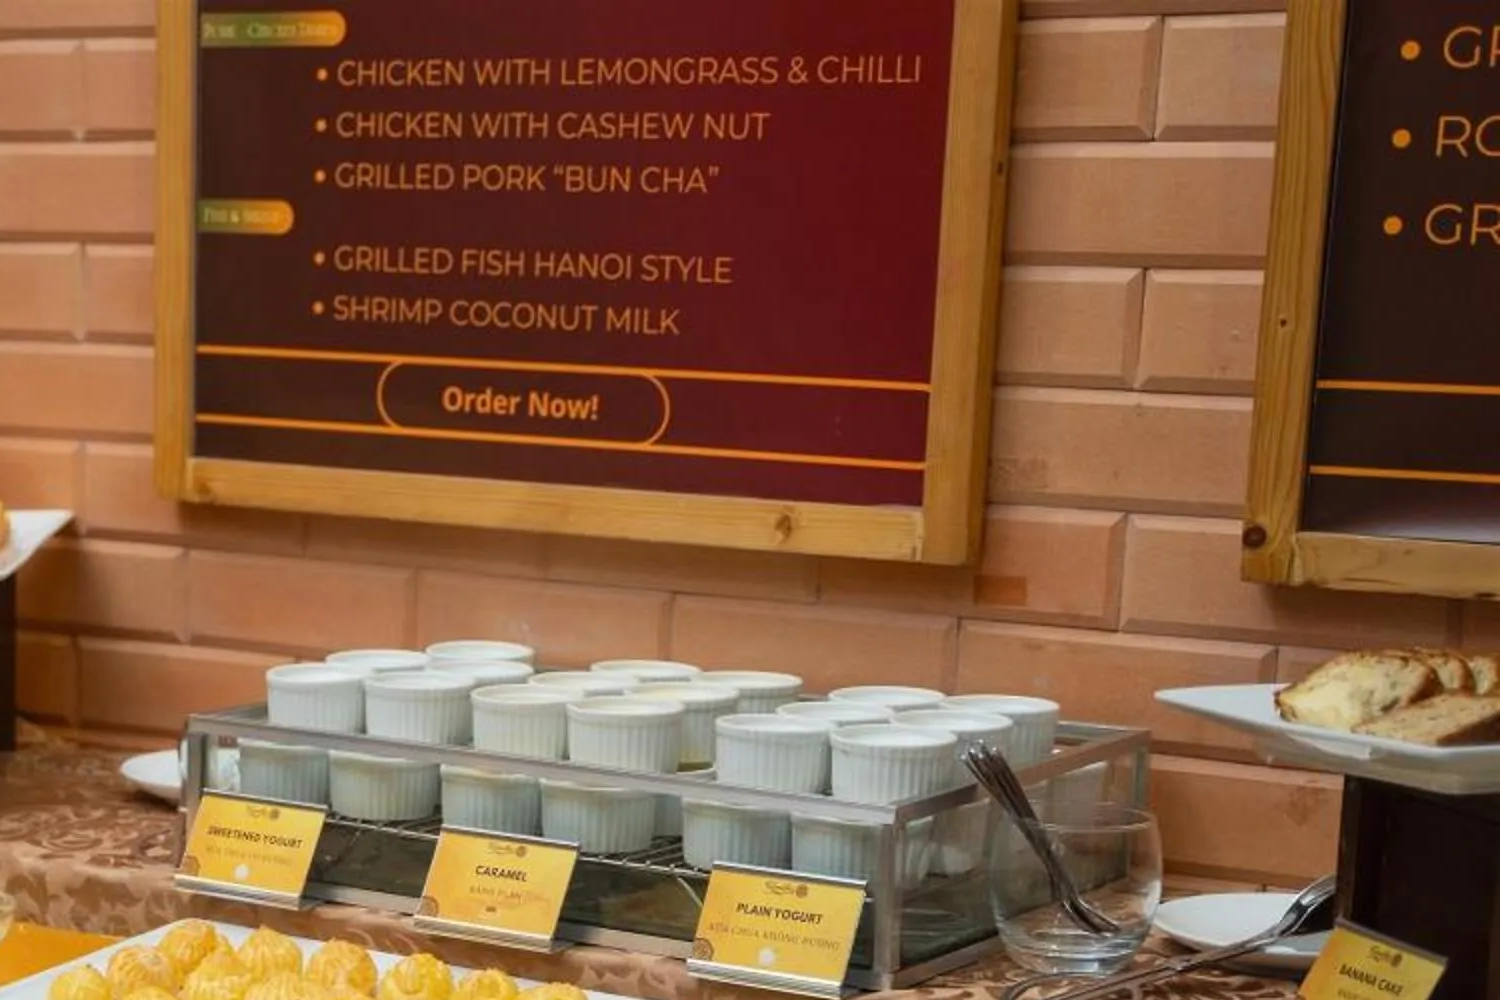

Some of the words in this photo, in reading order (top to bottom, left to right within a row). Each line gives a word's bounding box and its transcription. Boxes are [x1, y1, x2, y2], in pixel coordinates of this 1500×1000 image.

[336, 58, 466, 87] CHICKEN
[472, 57, 551, 86] WITH
[559, 56, 780, 86] LEMONGRASS
[786, 56, 809, 84] &
[816, 54, 922, 84] CHILLI
[335, 111, 464, 139] CHICKEN
[470, 111, 550, 139] WITH
[556, 111, 695, 140] CASHEW
[702, 112, 772, 141] NUT
[333, 162, 456, 190] GRILLED
[462, 163, 547, 192] PORK
[333, 245, 455, 275] GRILLED
[460, 248, 526, 277] FISH
[533, 252, 633, 281] HANOI
[640, 254, 733, 285] STYLE
[332, 294, 444, 326] SHRIMP
[448, 299, 599, 332] COCONUT
[605, 307, 681, 336] MILK
[441, 385, 521, 417] Order
[527, 391, 600, 422] Now!
[206, 825, 261, 843] SWEETENED
[262, 833, 303, 849] YOGURT
[474, 864, 528, 883] CARAMEL
[735, 902, 772, 921] PLAIN
[773, 907, 824, 925] YOGURT
[1338, 963, 1378, 986] BANANA
